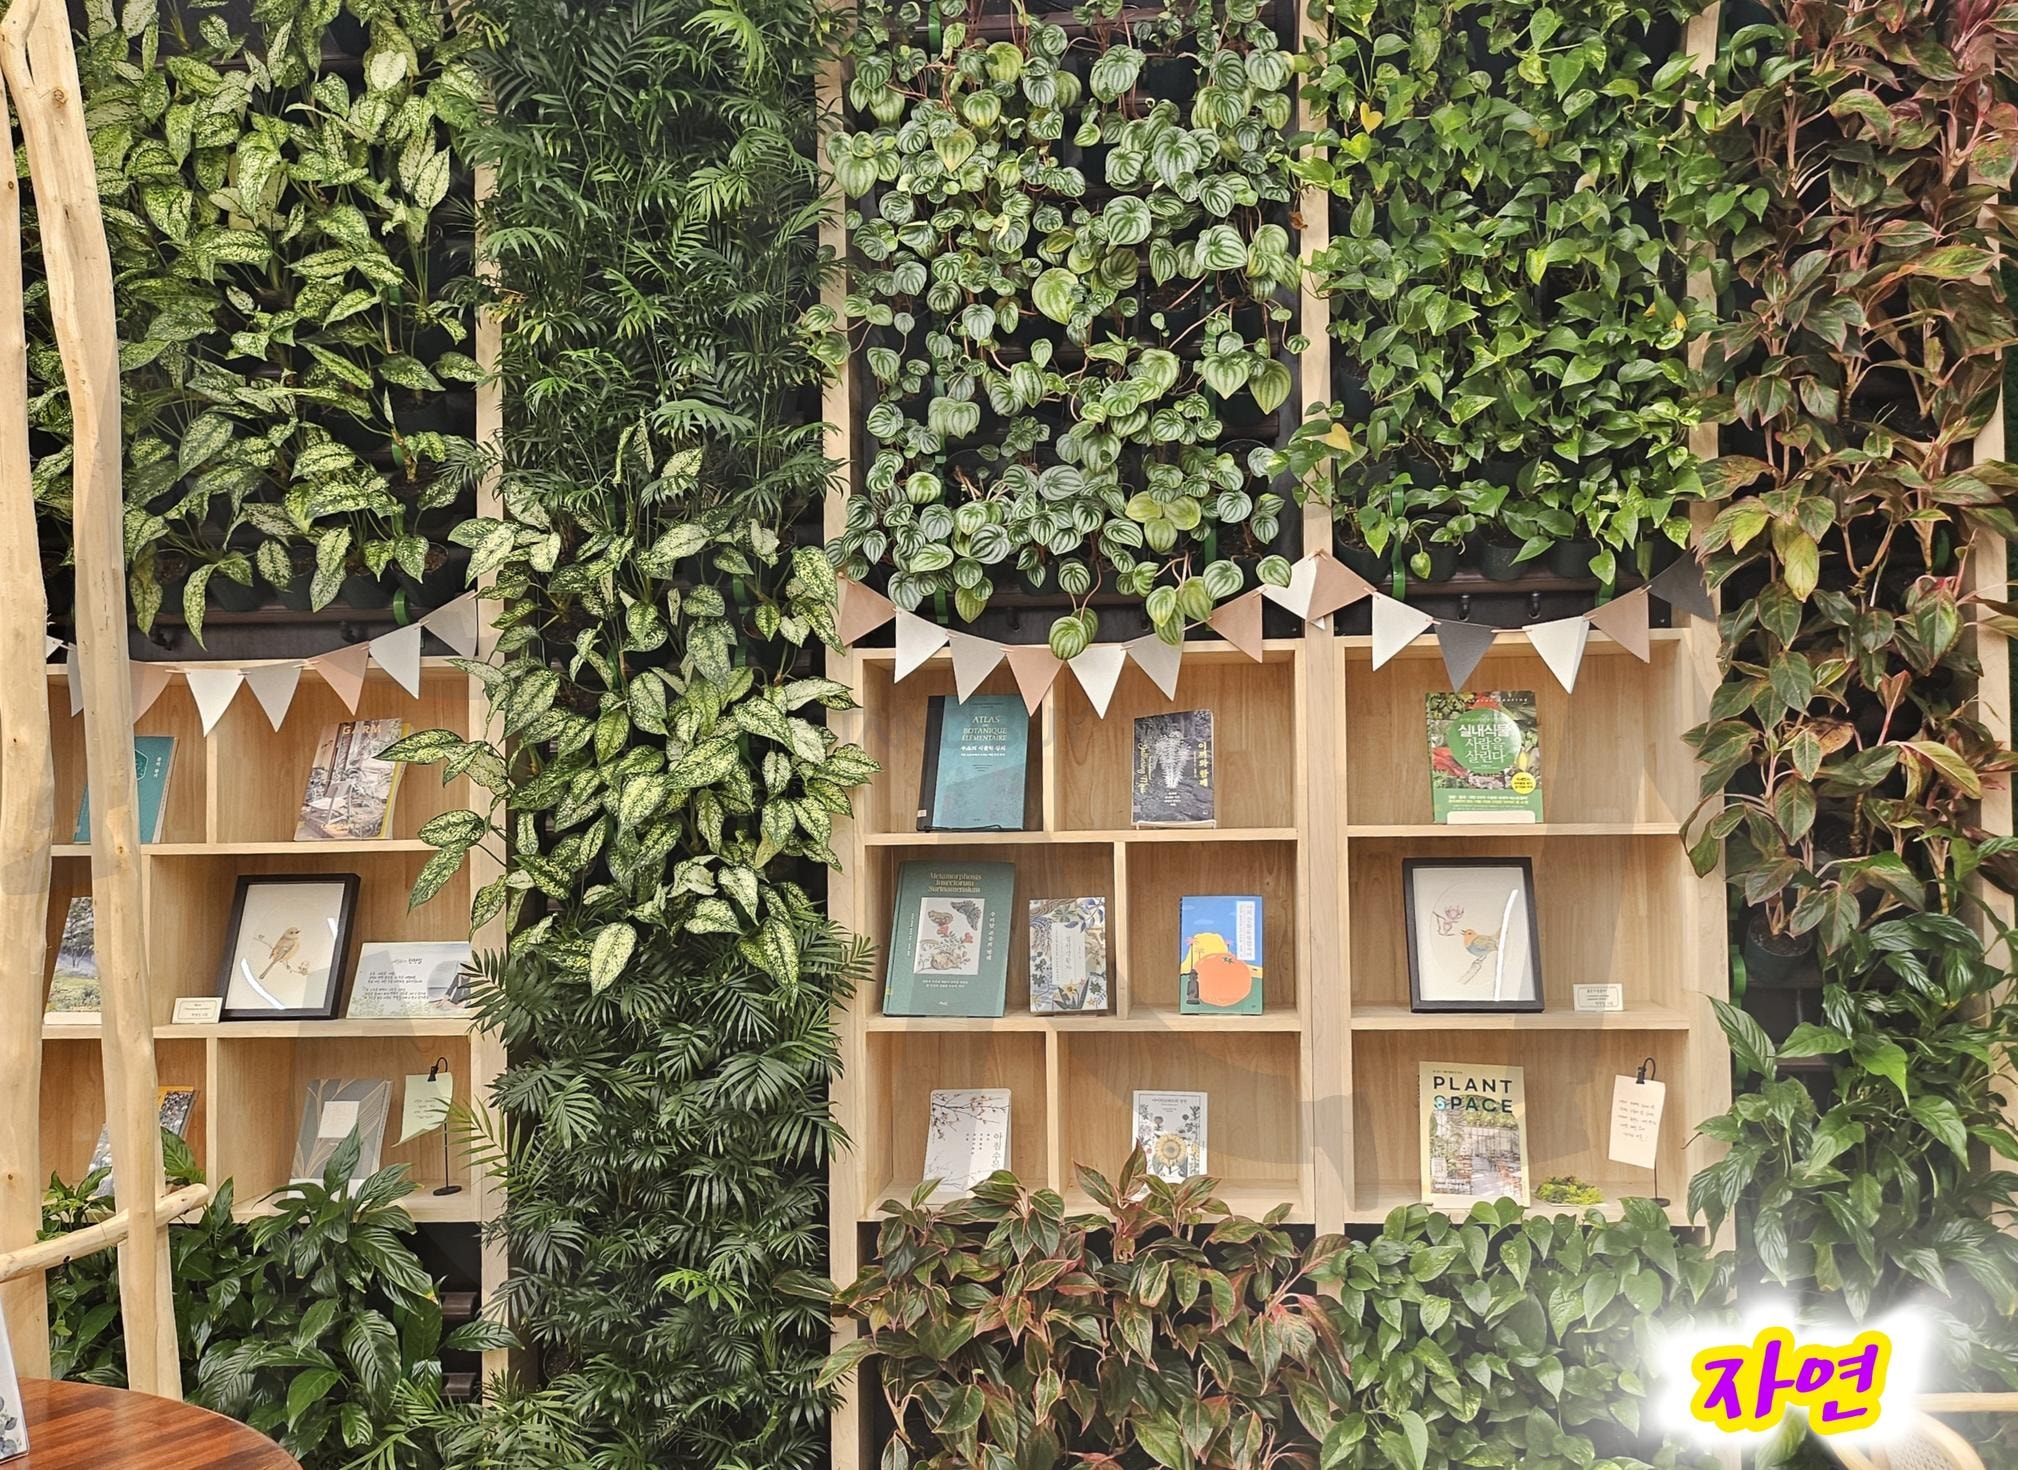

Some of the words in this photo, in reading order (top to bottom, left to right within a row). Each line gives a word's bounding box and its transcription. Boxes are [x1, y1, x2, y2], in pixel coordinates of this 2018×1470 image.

[343, 726, 381, 735] GRM
[963, 727, 1008, 735] BOTANIQUE
[1458, 723, 1511, 737] 실내식물
[1465, 737, 1505, 750] 사람을
[1465, 750, 1505, 763] 살린다
[1433, 1076, 1513, 1094] PLANT
[1433, 1095, 1513, 1113] SPACE
